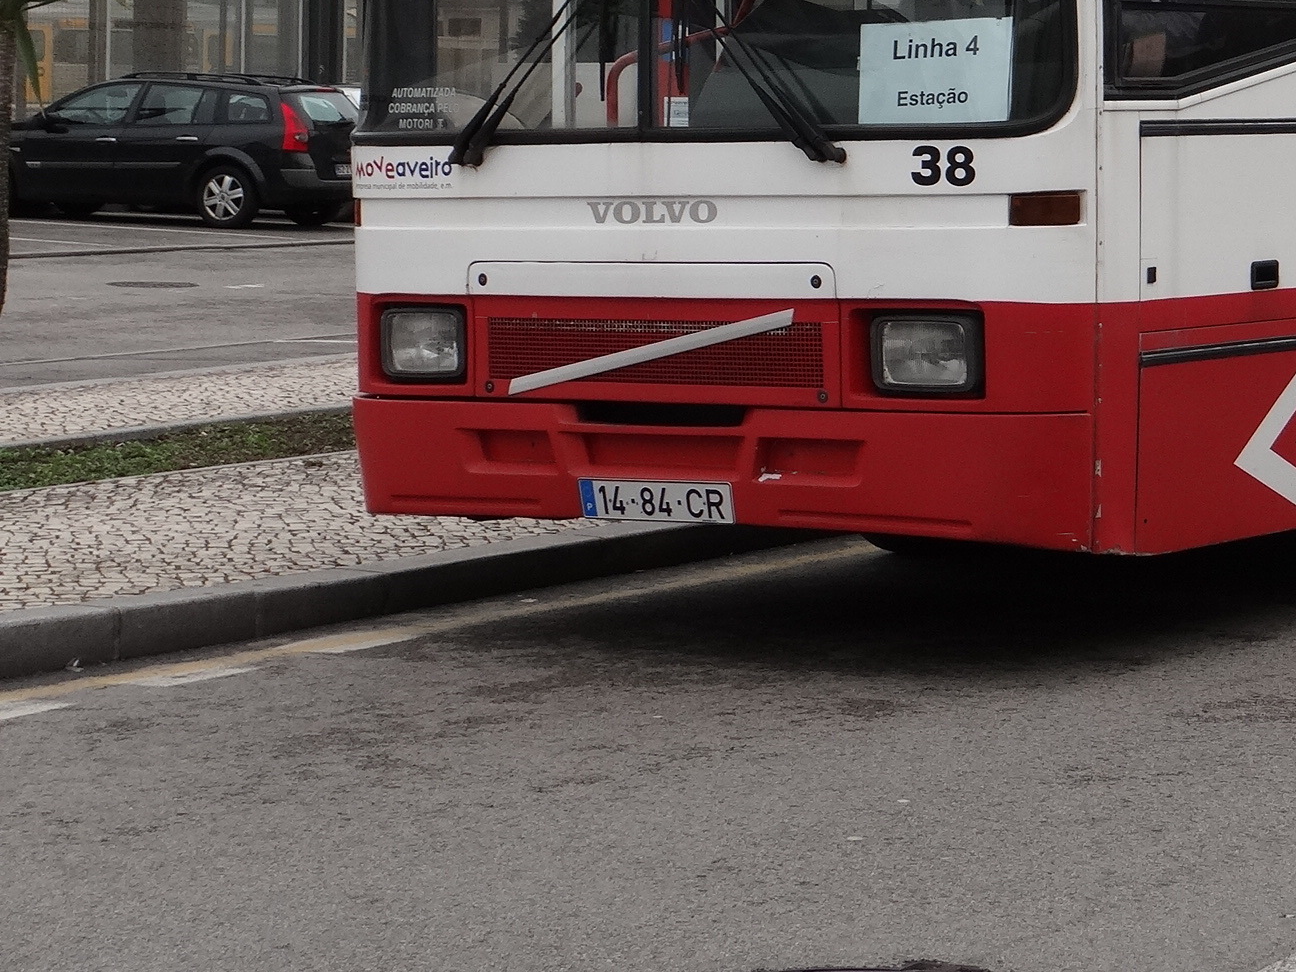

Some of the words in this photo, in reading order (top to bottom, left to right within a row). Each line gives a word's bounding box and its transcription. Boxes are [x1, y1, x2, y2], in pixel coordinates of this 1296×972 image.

[892, 37, 958, 60] Linha
[965, 35, 980, 56] 4
[391, 87, 456, 98] AUTOMATIZADA
[897, 87, 969, 109] Estação
[388, 102, 435, 116] COBRANÇA
[910, 145, 976, 187] 38
[586, 199, 718, 225] VOLVO
